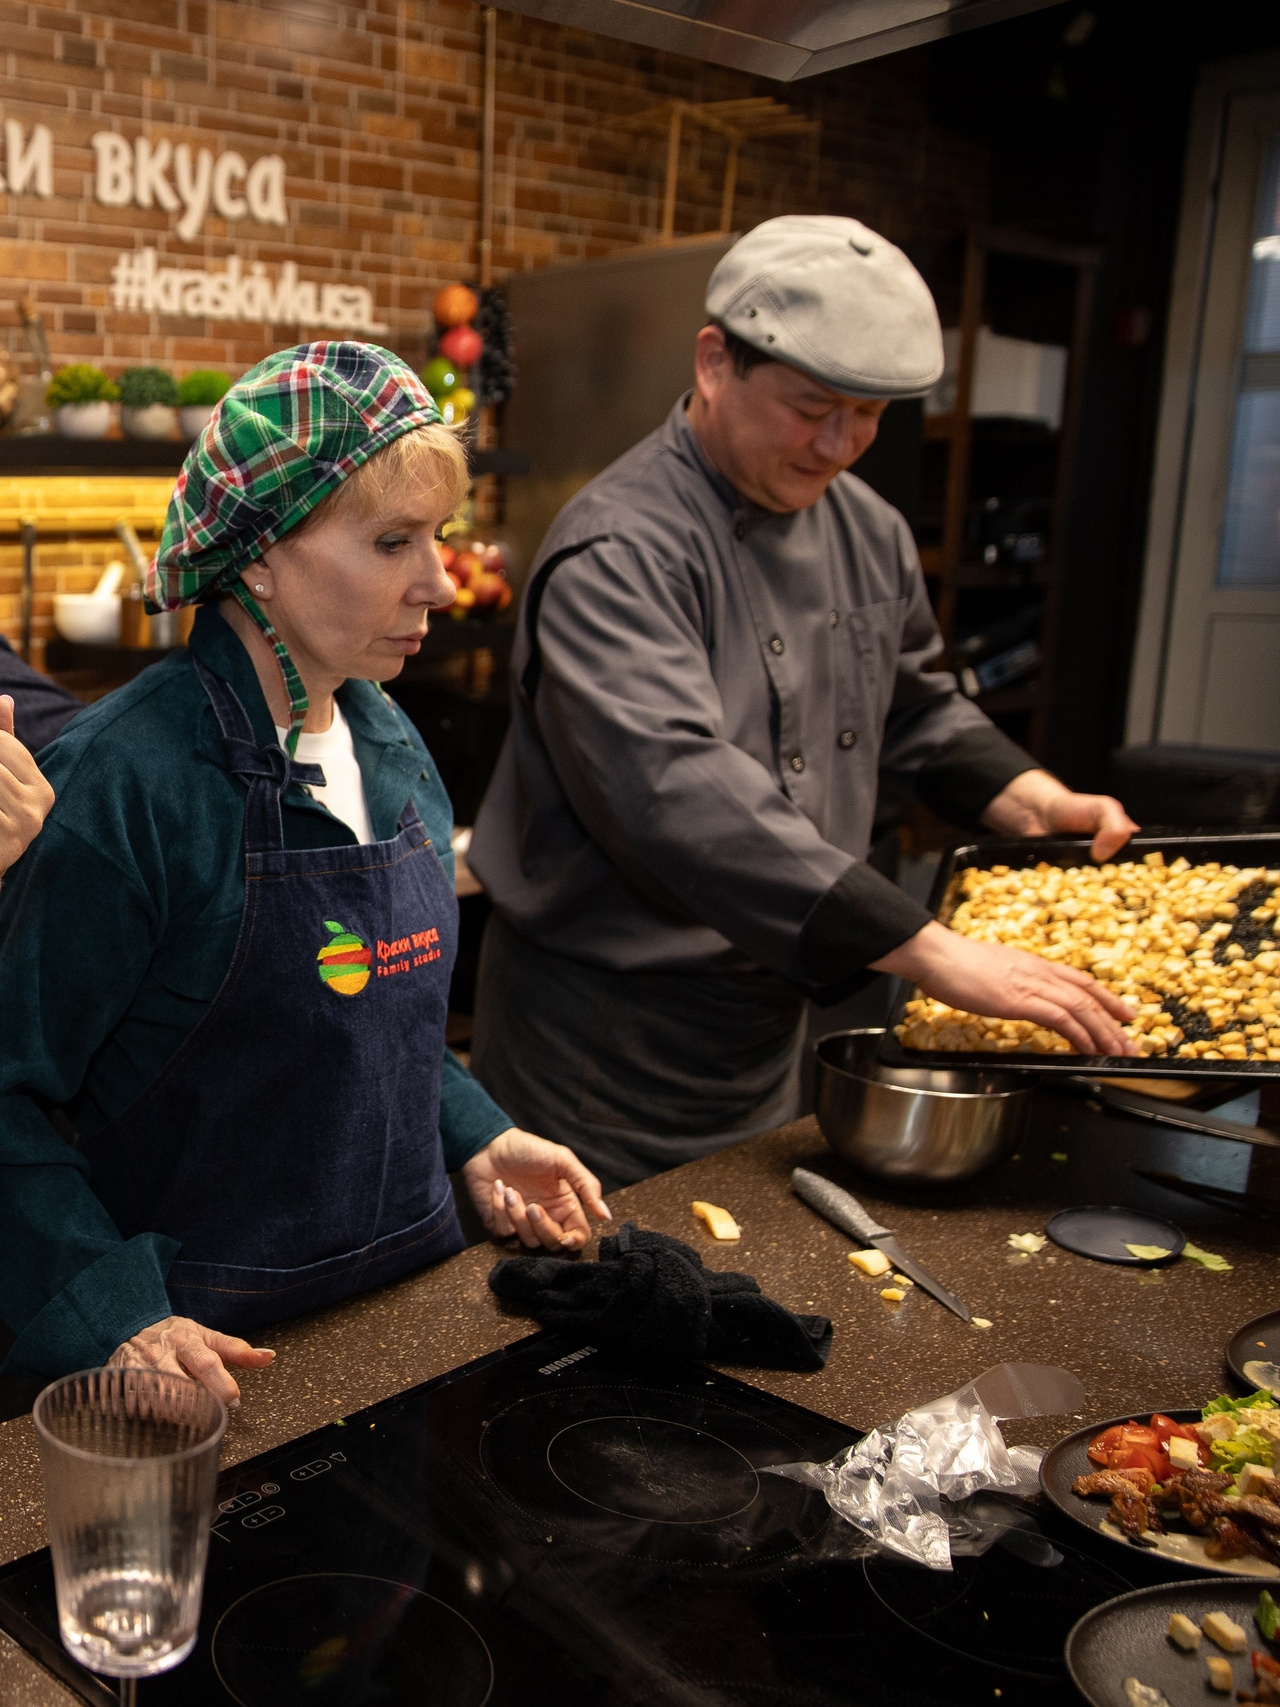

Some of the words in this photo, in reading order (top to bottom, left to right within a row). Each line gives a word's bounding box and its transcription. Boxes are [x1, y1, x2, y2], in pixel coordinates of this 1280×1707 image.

[91, 130, 288, 241] вкуса
[376, 959, 410, 978] Family
[538, 1346, 598, 1375] SAMSUNG
